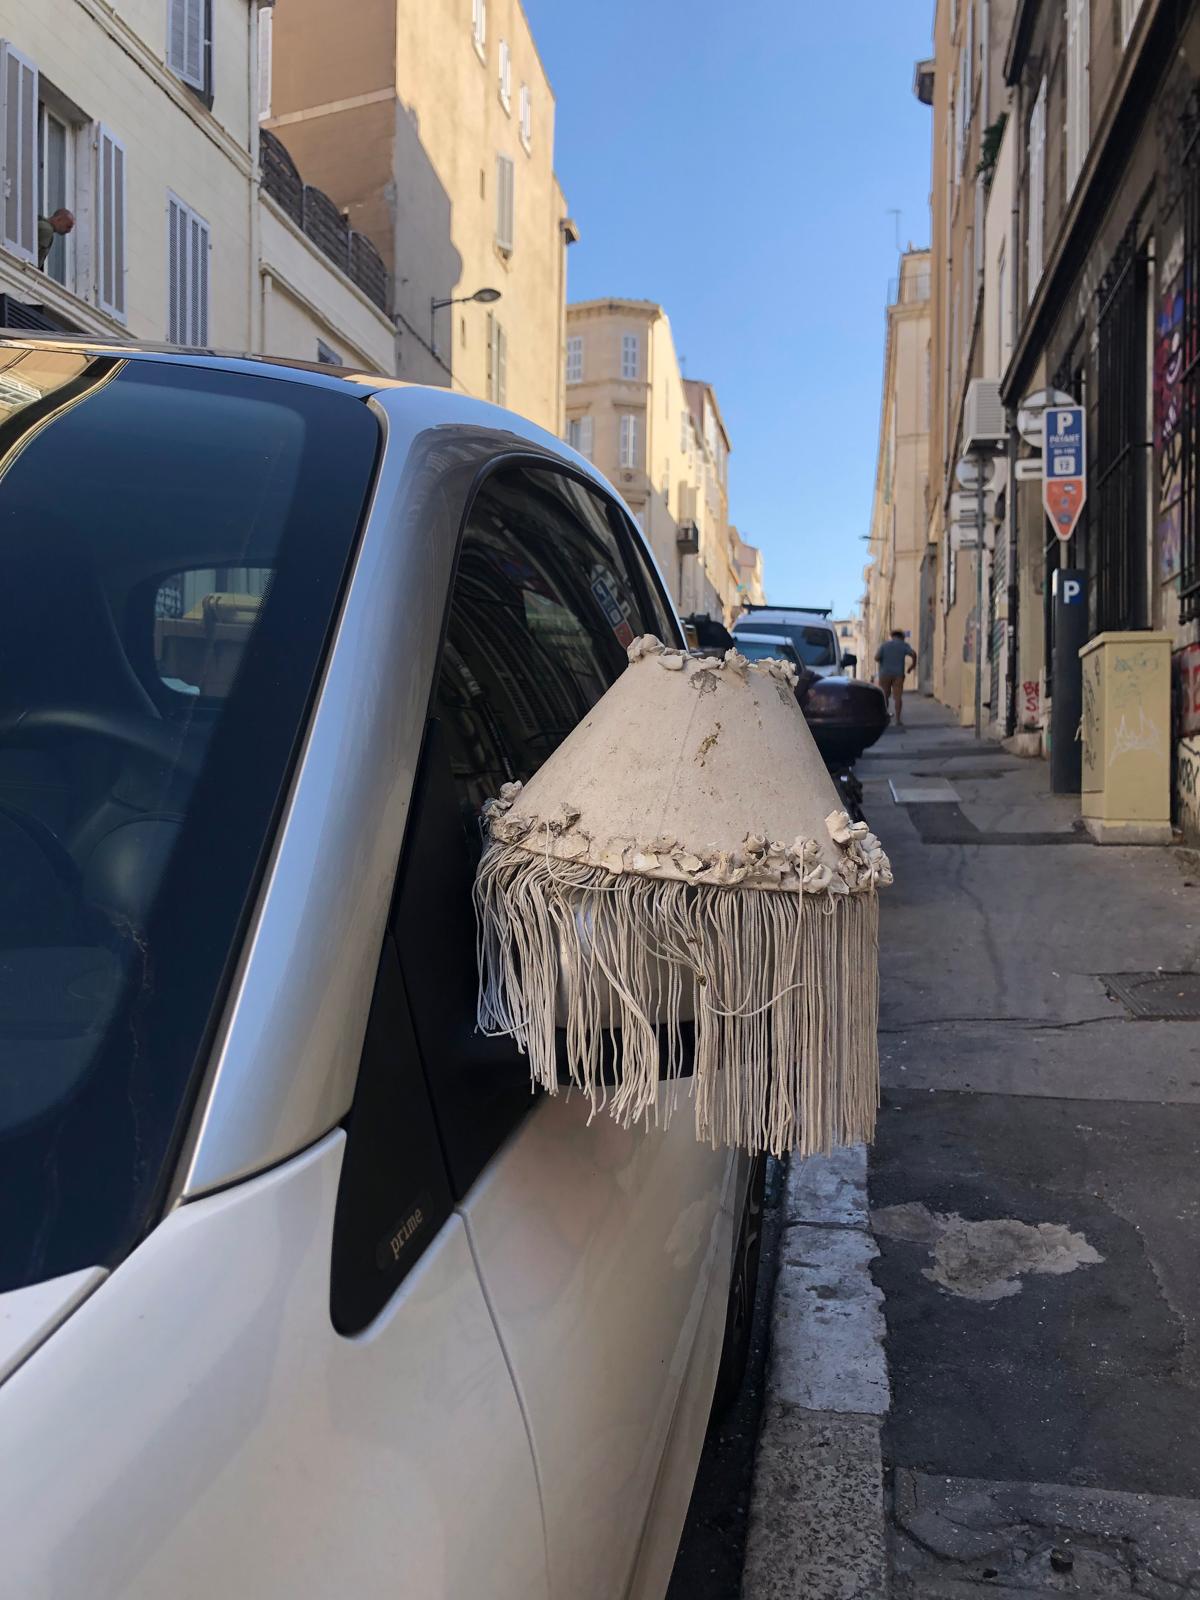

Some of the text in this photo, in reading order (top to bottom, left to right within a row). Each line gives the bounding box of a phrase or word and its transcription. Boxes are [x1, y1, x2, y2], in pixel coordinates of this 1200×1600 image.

[1057, 411, 1073, 435] P
[1049, 433, 1080, 444] PAYANT
[1063, 580, 1080, 604] P
[390, 1208, 423, 1260] prime
